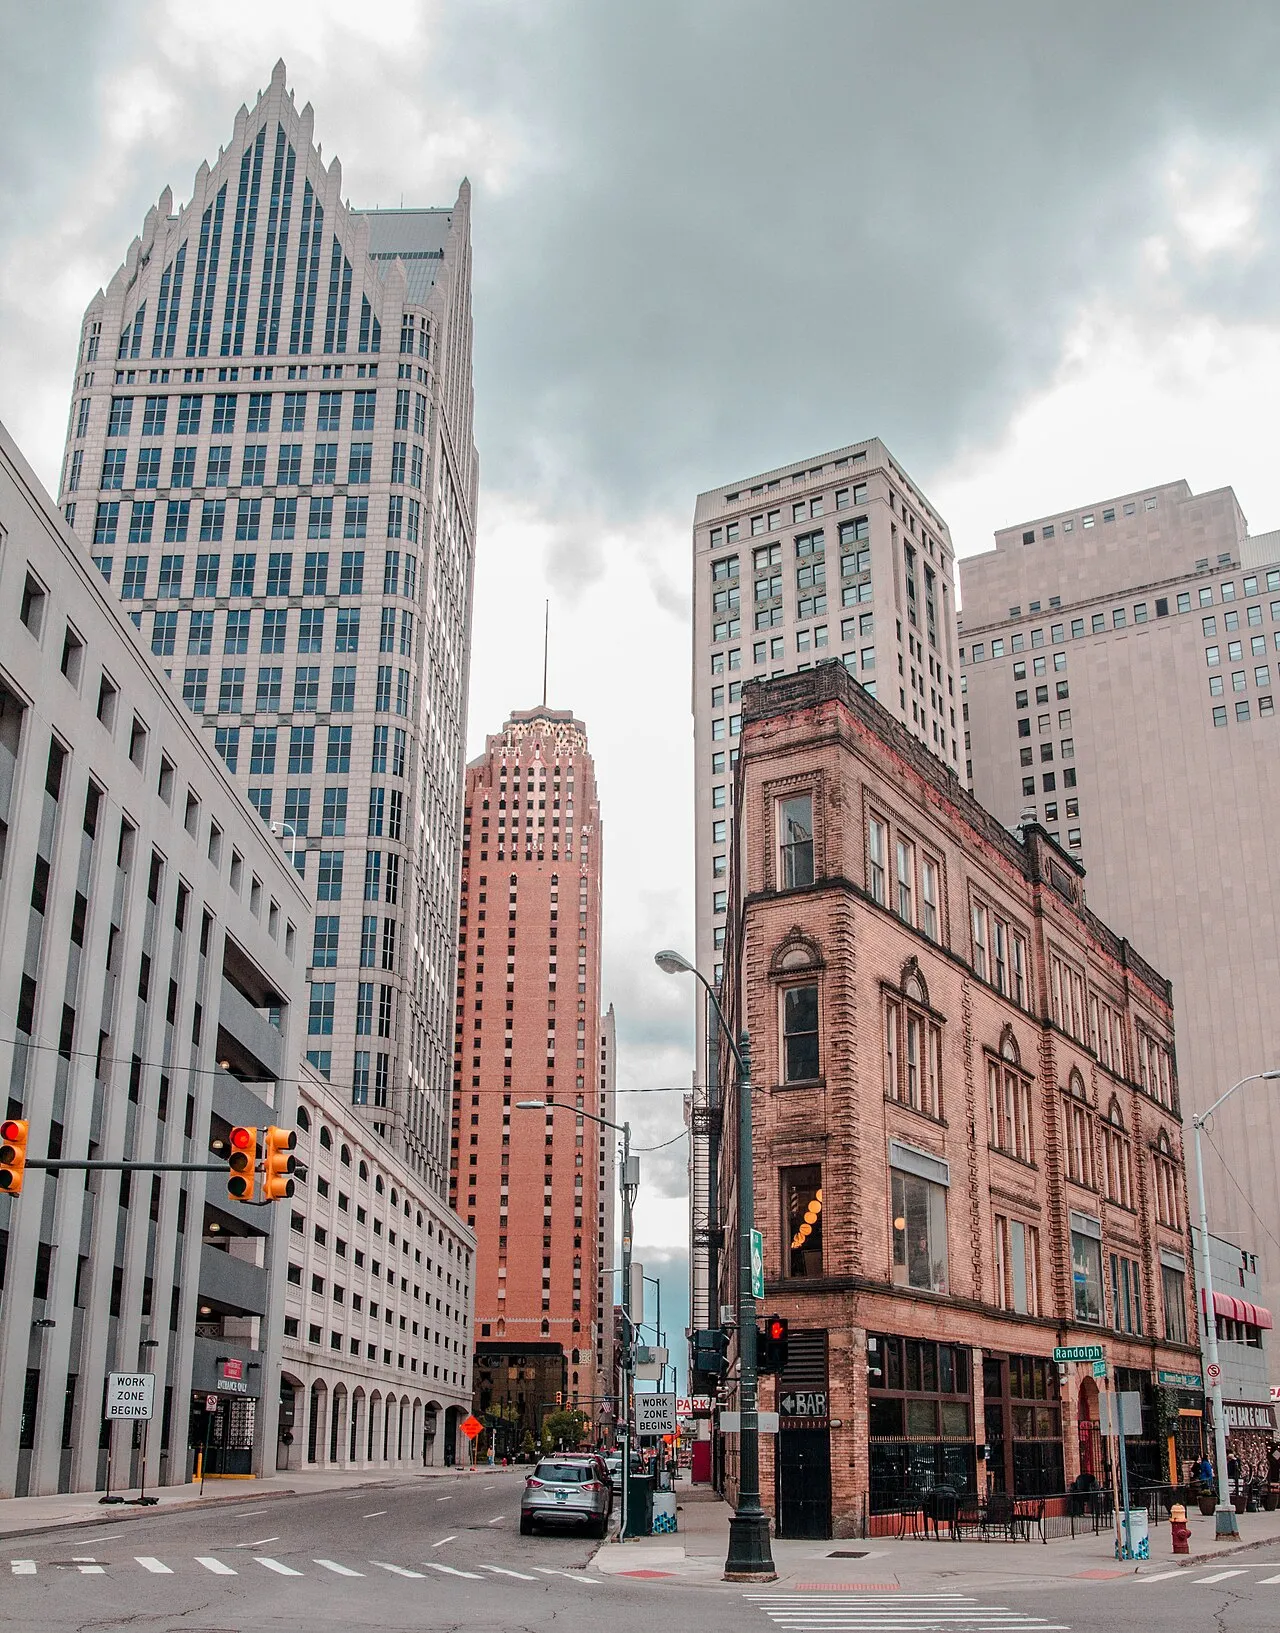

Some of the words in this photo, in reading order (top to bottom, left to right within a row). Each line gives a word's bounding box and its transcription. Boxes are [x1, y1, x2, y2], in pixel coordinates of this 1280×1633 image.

[1055, 1346, 1100, 1360] Randolph
[117, 1377, 145, 1386] WORK
[117, 1391, 144, 1400] ZONE
[642, 1398, 668, 1407] WORK
[677, 1399, 706, 1410] PARK
[795, 1393, 826, 1415] BAR
[111, 1405, 148, 1415] BEGINS
[644, 1410, 668, 1419] ZONE
[640, 1421, 673, 1431] BEGINS
